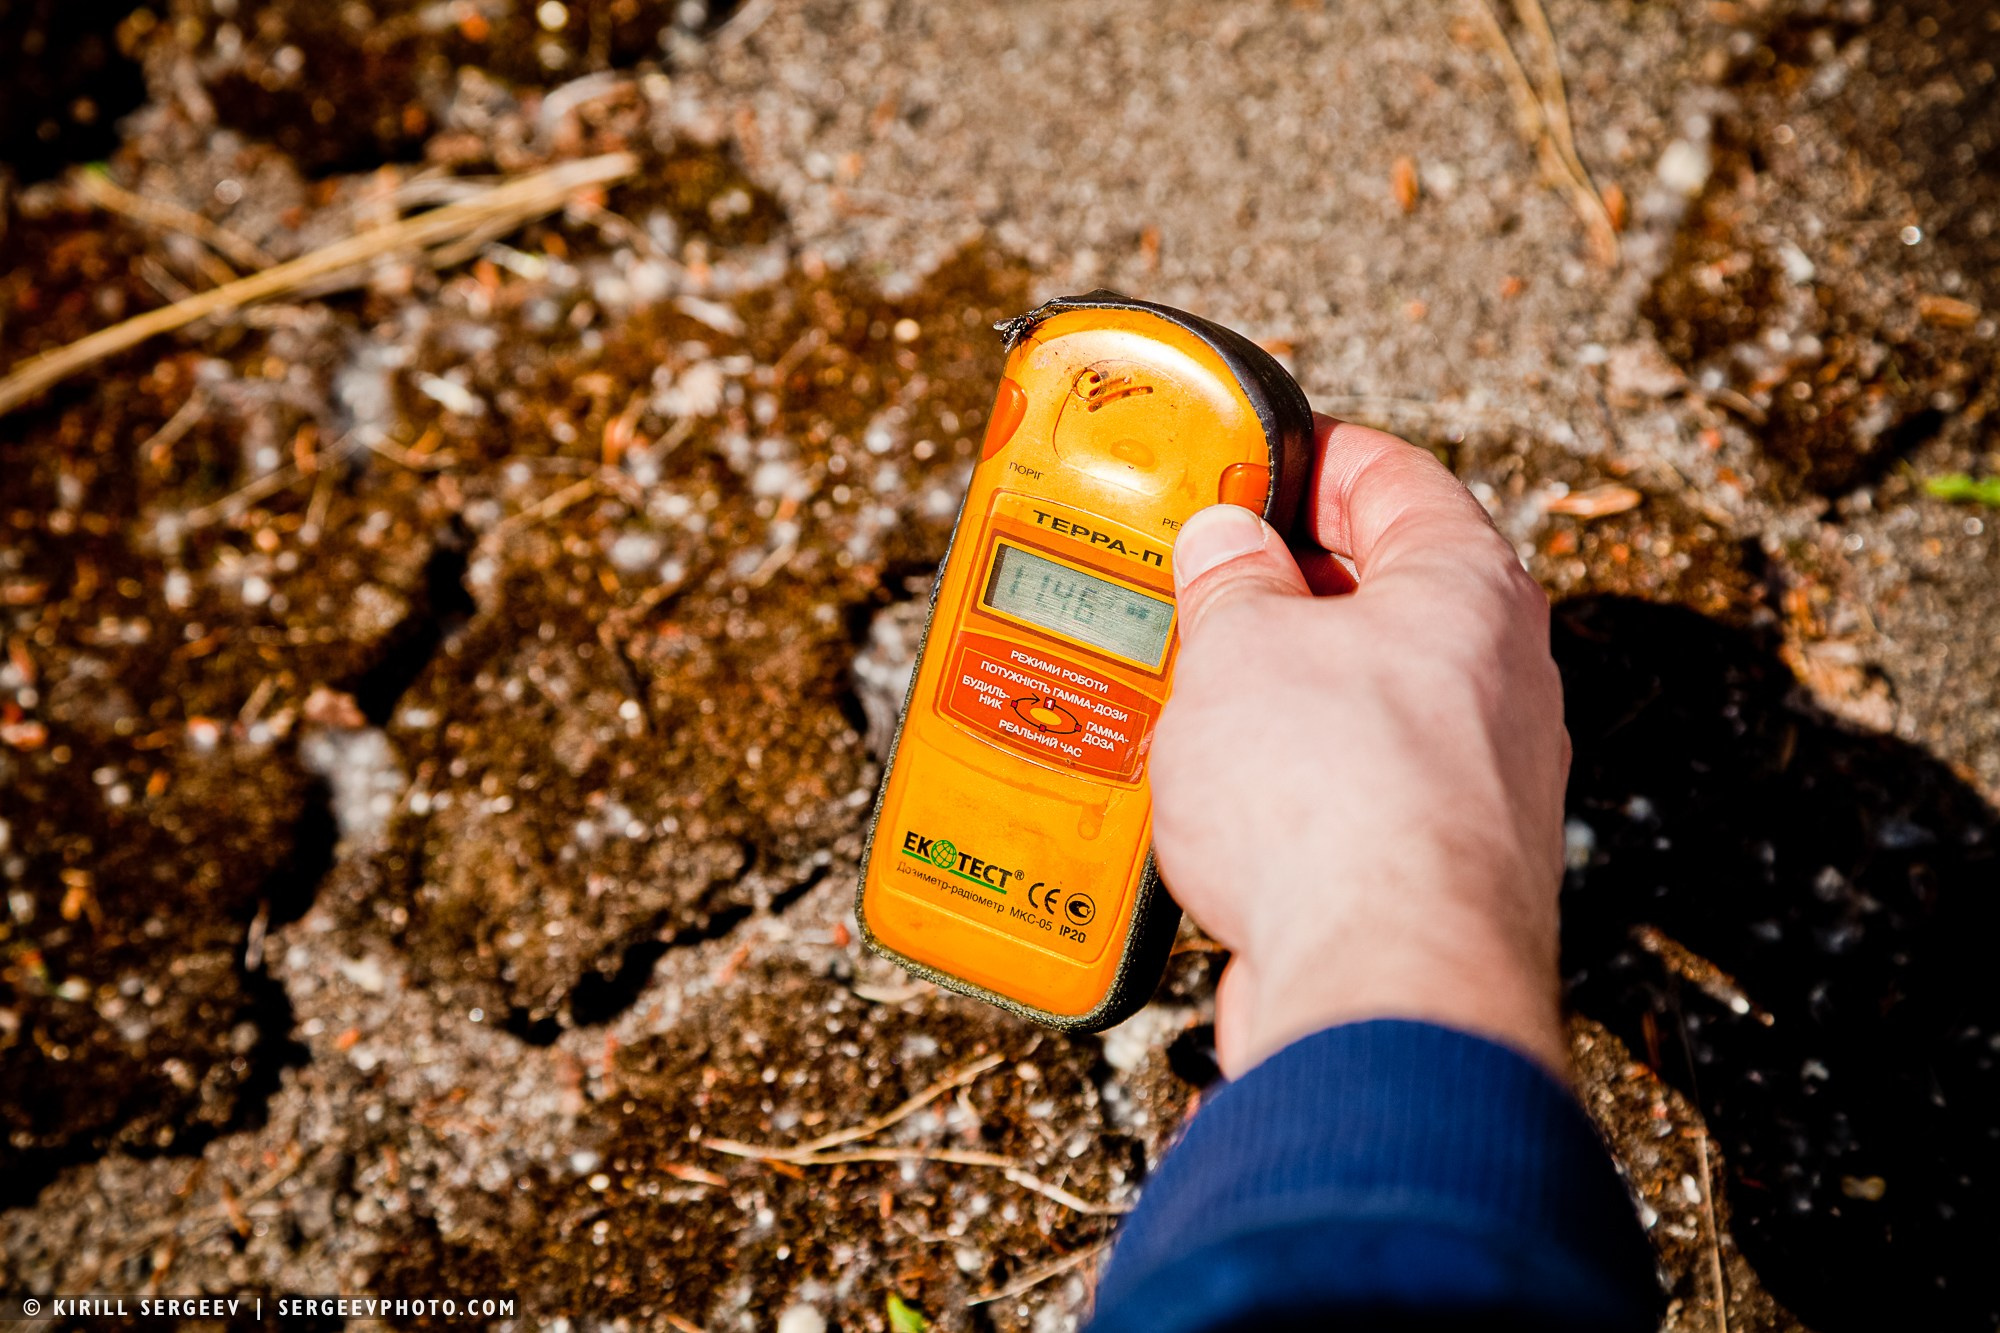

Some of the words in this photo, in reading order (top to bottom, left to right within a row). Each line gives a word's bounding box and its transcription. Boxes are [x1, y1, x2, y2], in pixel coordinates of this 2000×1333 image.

[1009, 462, 1045, 481] ПОРІГ
[1033, 509, 1164, 567] ТЕРРА-П
[1010, 650, 1061, 677] РЕЖИМИ
[1062, 671, 1109, 694] РОБОТИ
[962, 674, 1011, 700] БУДИЛЬ-
[981, 660, 1051, 695] ПОТУЖНІСТЬ
[1052, 687, 1129, 723] ГАММА-ДОЗИ
[978, 693, 1003, 710] НИК
[998, 719, 1059, 750] РЕАЛЬНИЙ
[1060, 741, 1083, 758] ЧАС
[1081, 733, 1115, 752] ДОЗА
[1085, 721, 1130, 743] ГАММА-
[897, 861, 1005, 913] Дозиметр-радіометр
[1010, 906, 1053, 931] МКС-05
[1059, 924, 1087, 944] IP20
